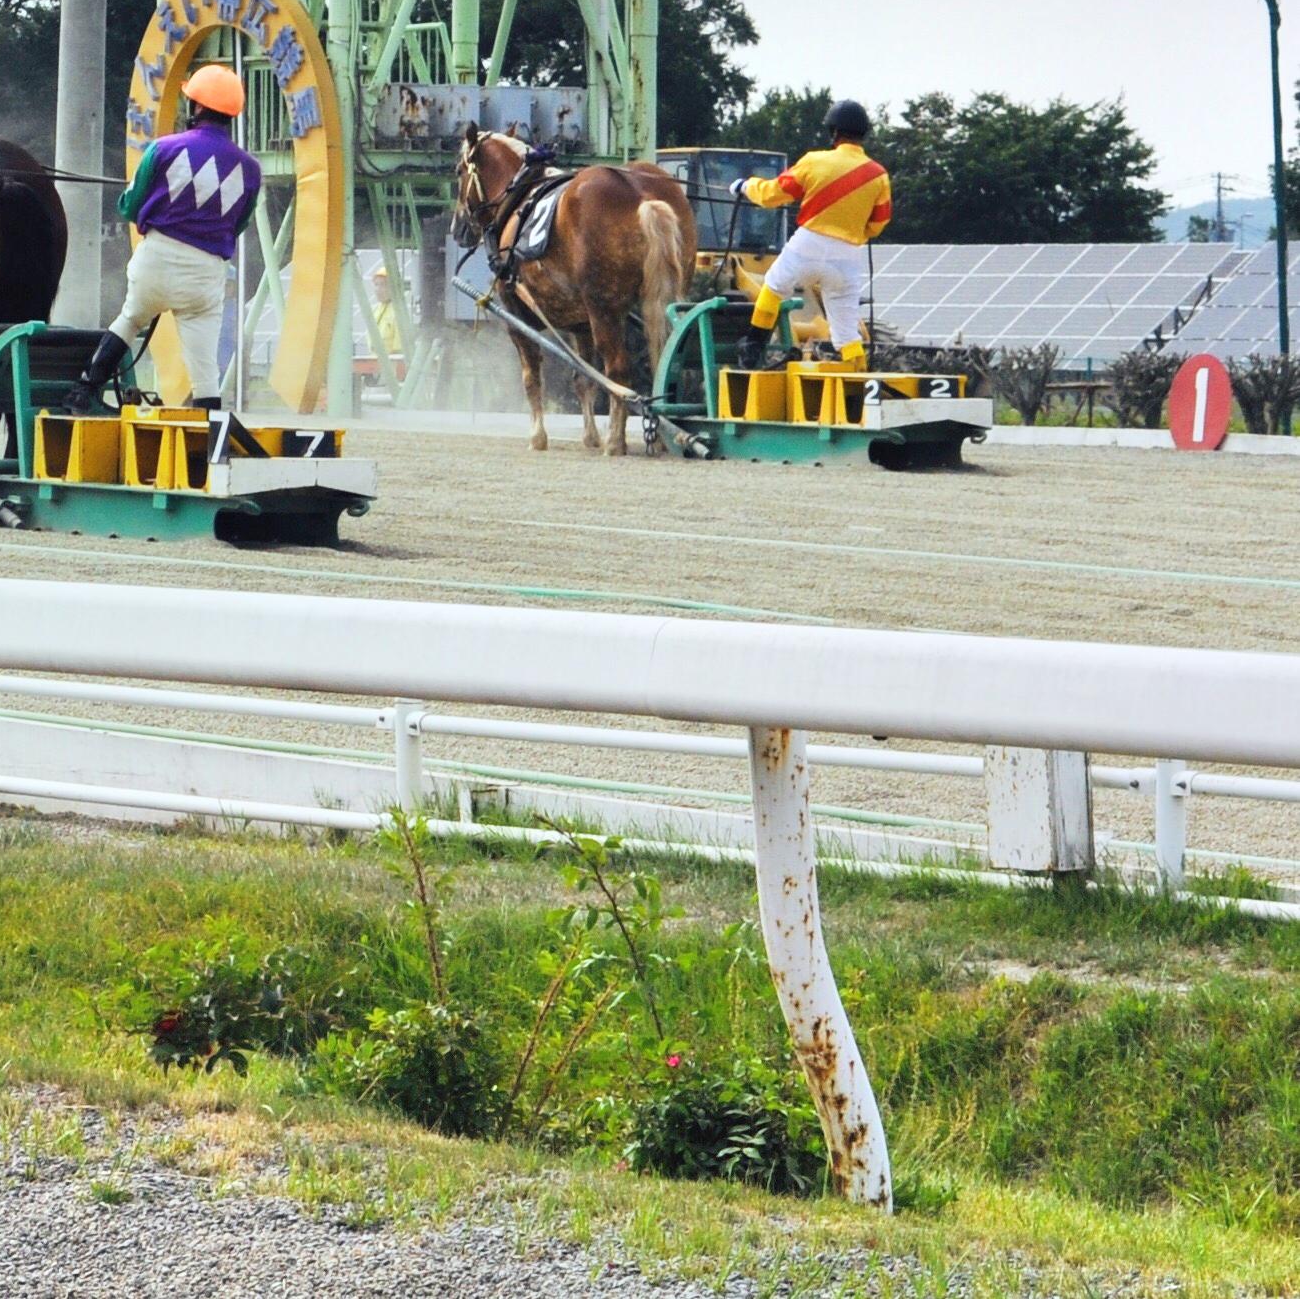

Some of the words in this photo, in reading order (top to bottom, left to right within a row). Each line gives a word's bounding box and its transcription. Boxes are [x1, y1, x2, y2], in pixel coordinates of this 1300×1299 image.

[528, 193, 556, 248] 2
[864, 379, 880, 405] 2
[930, 379, 951, 398] 2
[1192, 367, 1209, 442] 1
[209, 410, 231, 464] 7
[295, 431, 325, 458] 7
